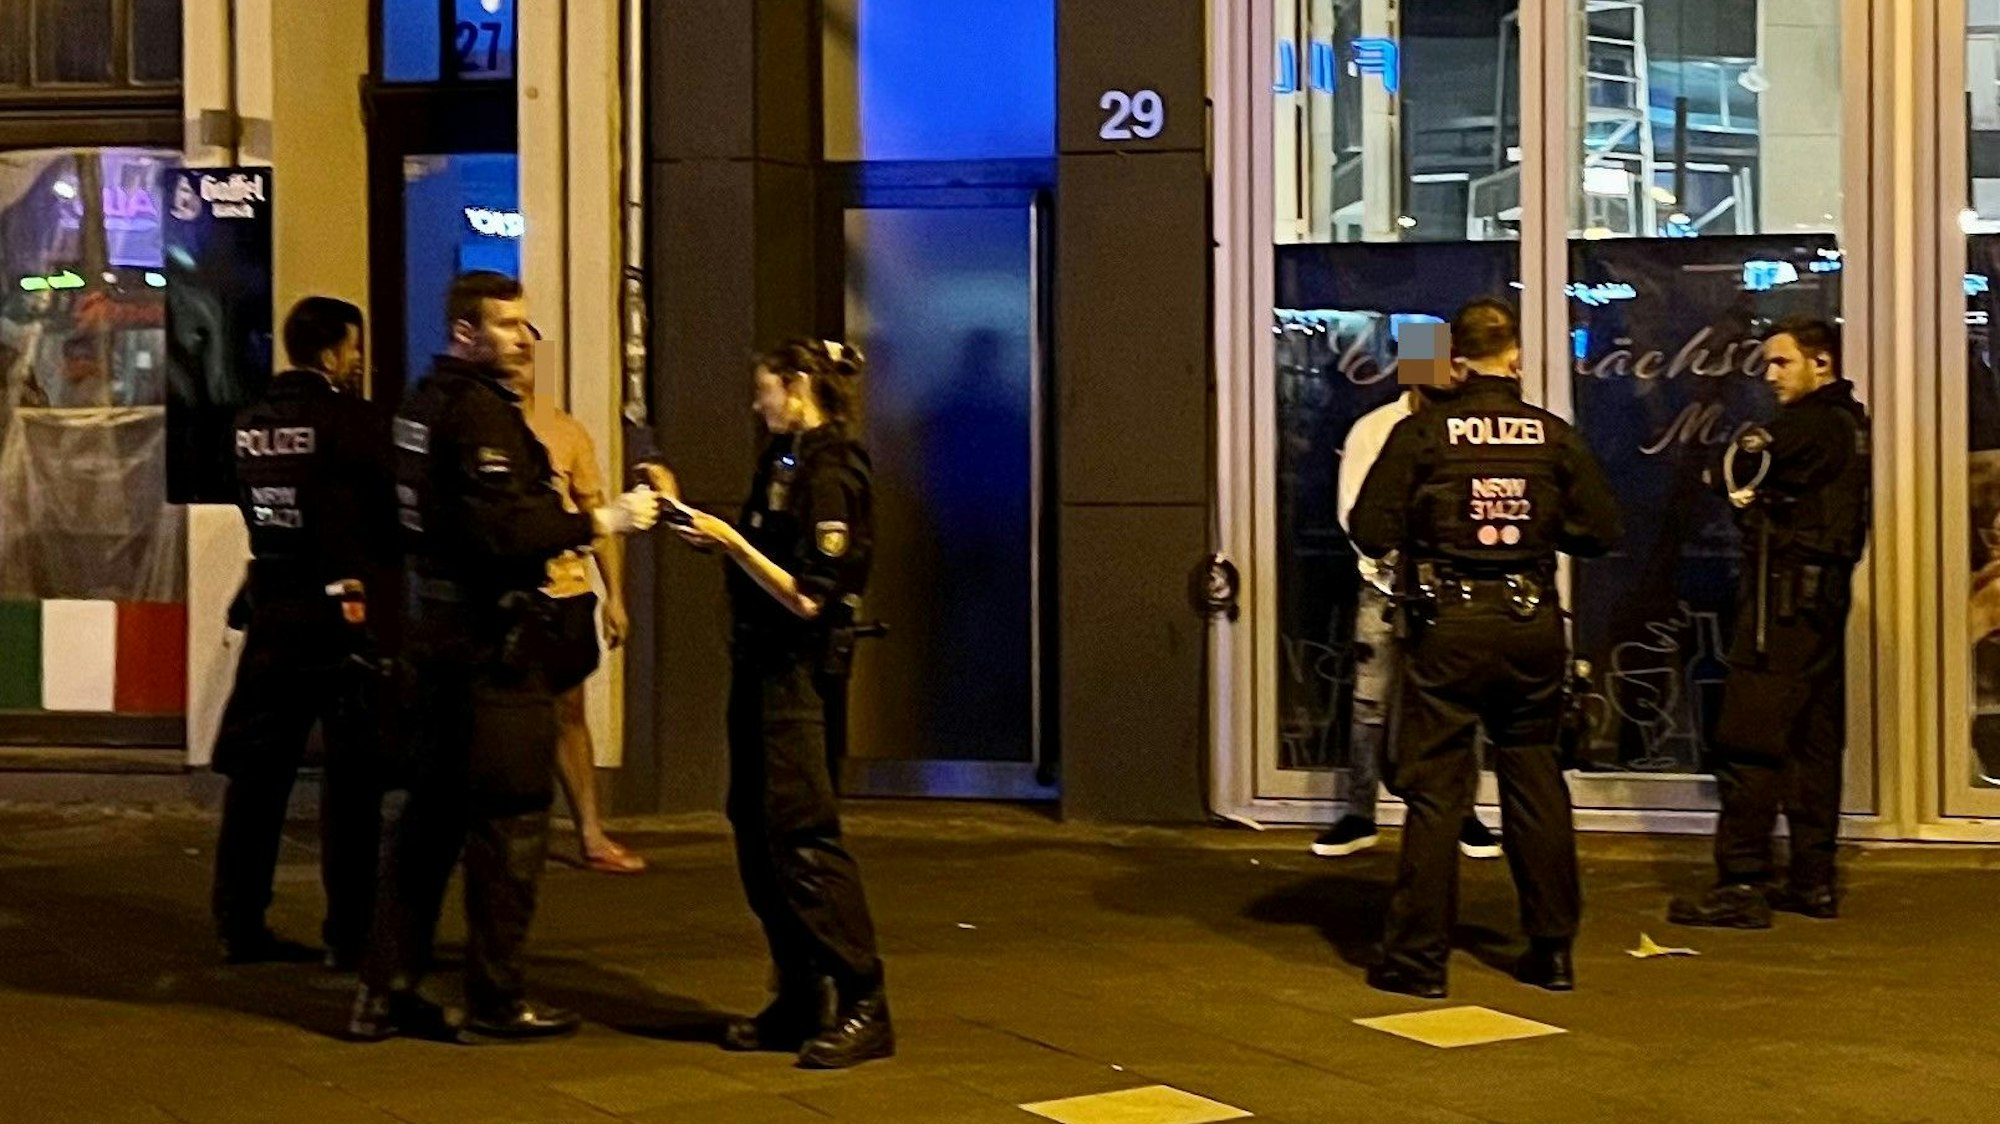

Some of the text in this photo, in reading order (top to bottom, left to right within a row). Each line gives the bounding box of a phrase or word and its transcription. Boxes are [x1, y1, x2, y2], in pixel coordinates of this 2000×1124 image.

[456, 21, 502, 72] 27
[1100, 90, 1164, 139] 29
[236, 427, 315, 458] POLIZEI
[1446, 416, 1546, 445] POLIZEI
[1471, 478, 1527, 499] NRW
